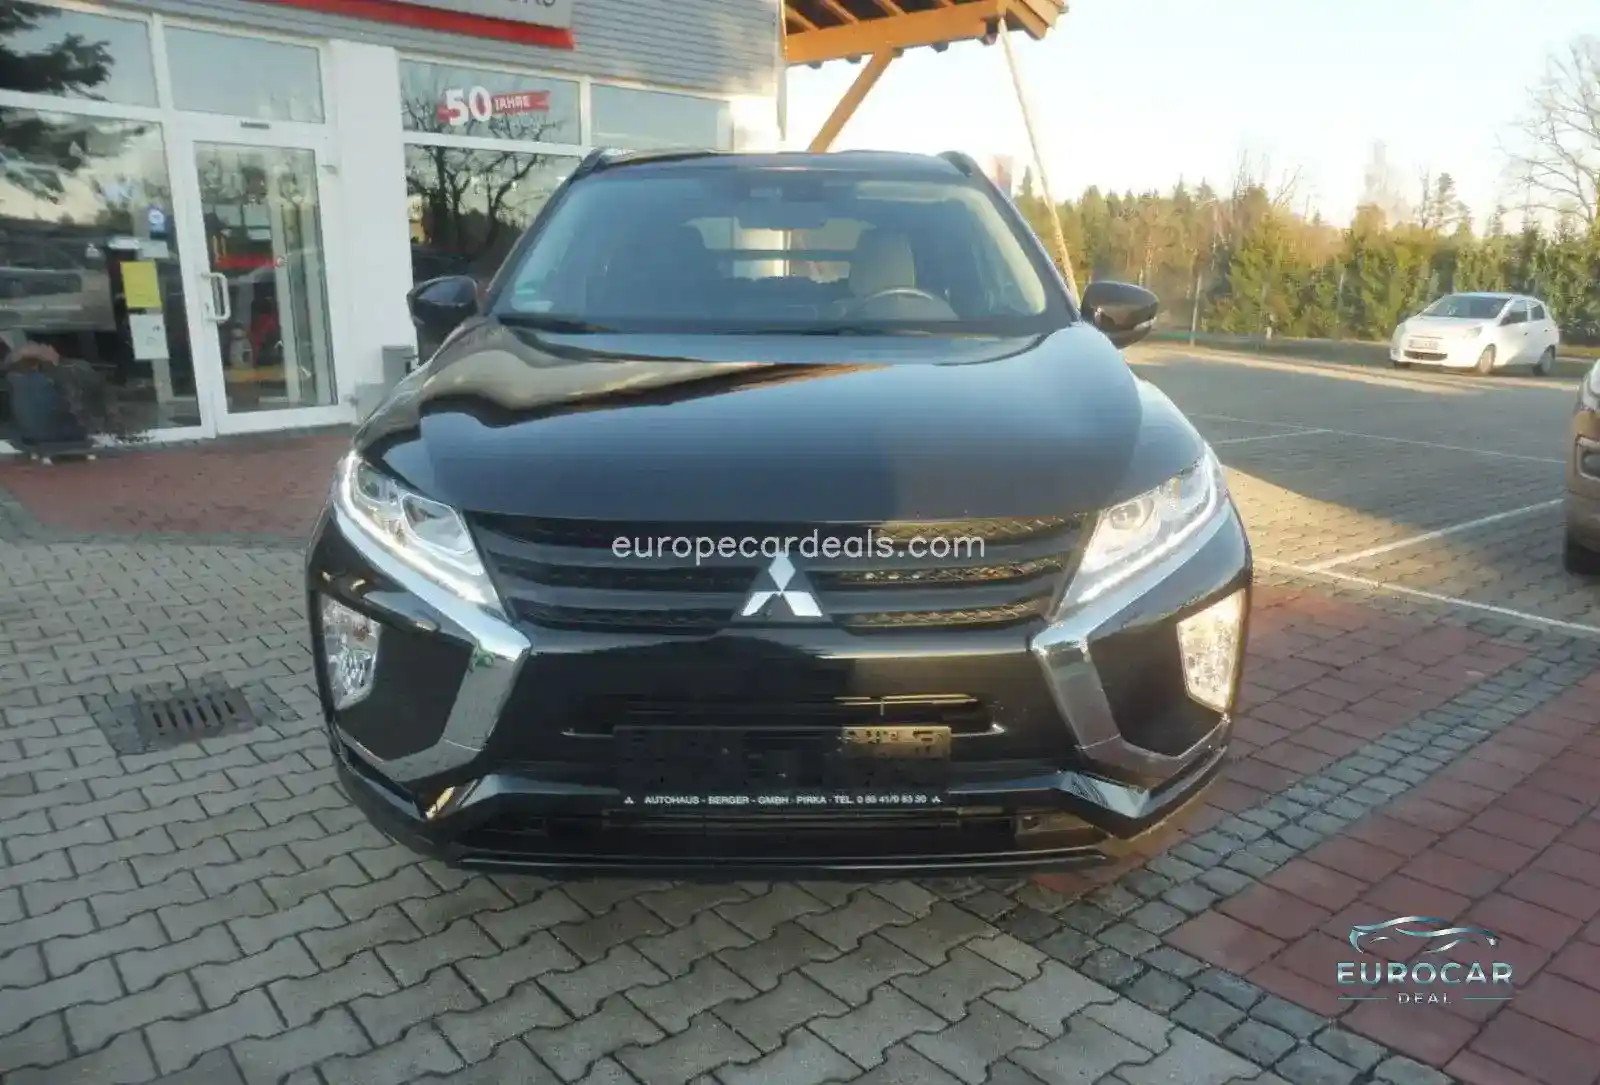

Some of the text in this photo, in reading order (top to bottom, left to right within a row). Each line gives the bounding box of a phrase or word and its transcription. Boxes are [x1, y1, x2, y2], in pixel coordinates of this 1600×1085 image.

[445, 85, 492, 126] 50
[645, 795, 700, 806] AUTOHAUS
[708, 795, 749, 806] BERGER
